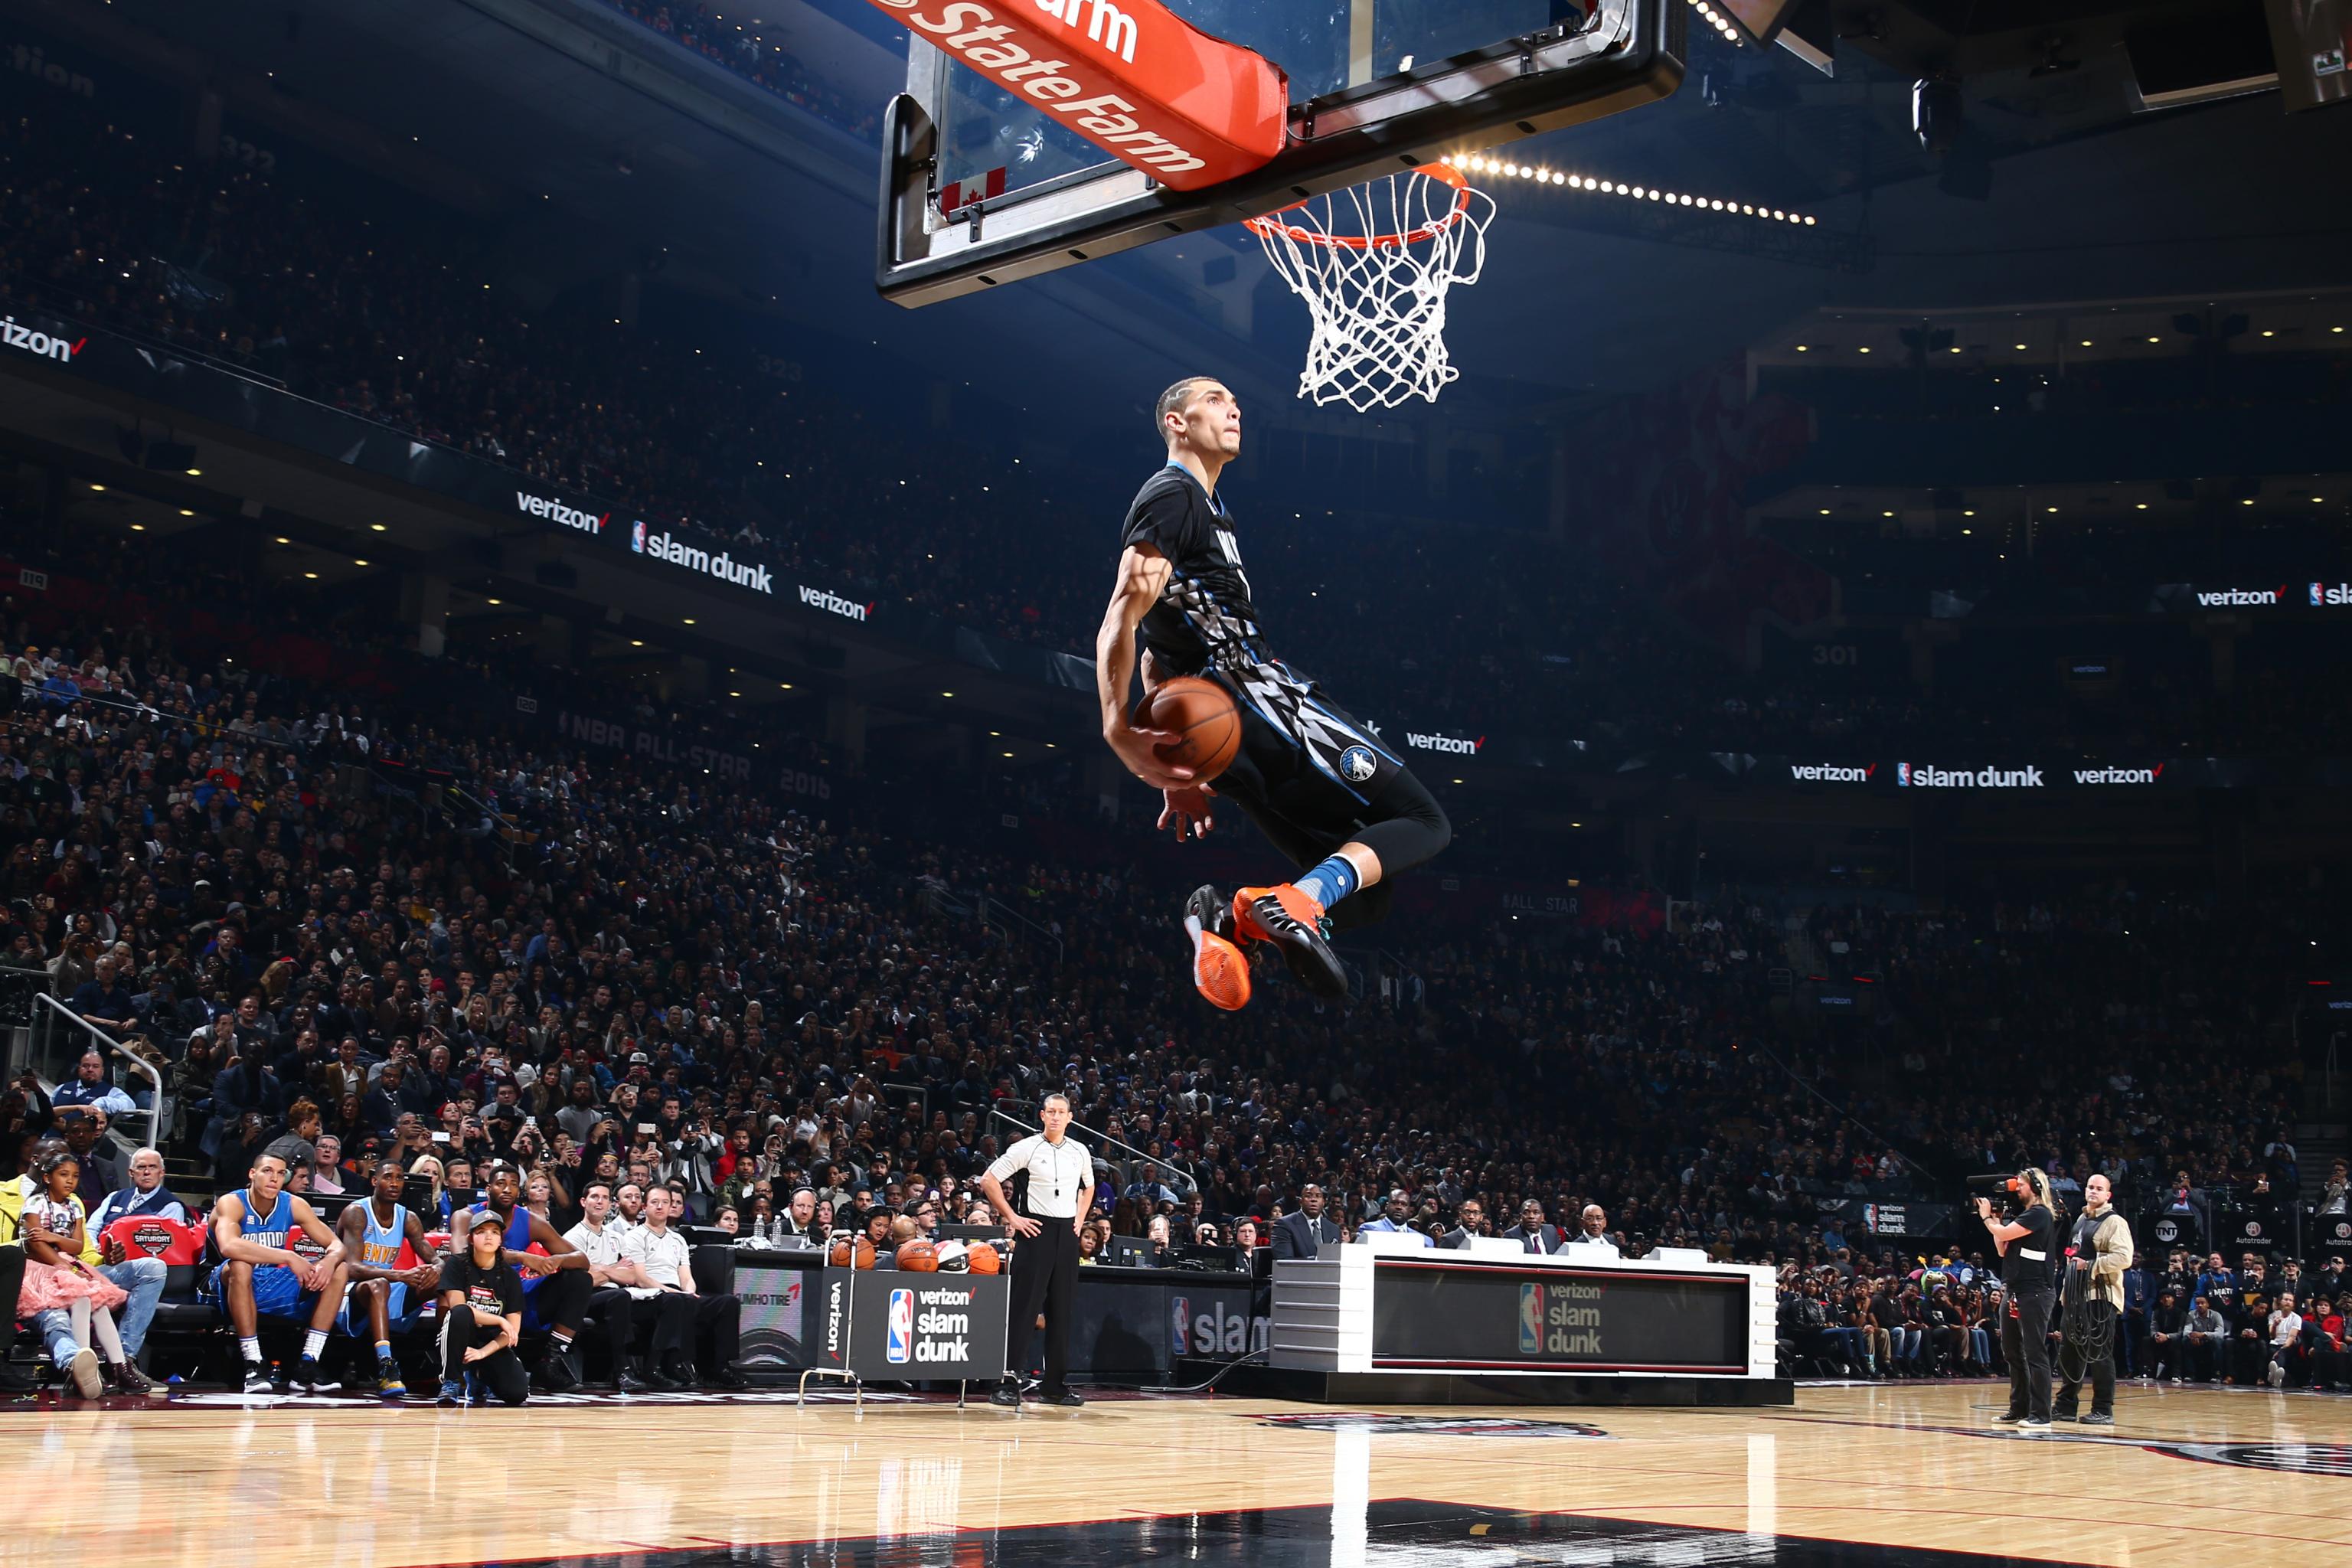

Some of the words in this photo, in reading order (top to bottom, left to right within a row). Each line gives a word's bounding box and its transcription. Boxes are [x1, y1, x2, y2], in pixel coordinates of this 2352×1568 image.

[516, 491, 599, 534] verizon
[646, 531, 710, 574] slam
[710, 551, 773, 594] dunk
[799, 584, 866, 622] verizon
[2197, 587, 2277, 606] verizon
[1812, 645, 1857, 665] 301
[572, 714, 625, 750] NBA
[635, 731, 751, 781] ALL-STAR
[1406, 732, 1476, 755] verizon
[1791, 763, 1867, 782] verizon
[1913, 765, 1975, 788] slam
[1976, 765, 2044, 788] dunk
[2073, 765, 2154, 785] verizon
[1511, 893, 1534, 910] ALL
[1546, 897, 1579, 914] STAR
[2155, 1227, 2177, 1237] TNT
[2236, 1236, 2272, 1245] Autotrader
[294, 1244, 327, 1253] SATURDA
[769, 1294, 791, 1306] TIRE
[919, 1287, 969, 1305] verizon
[1550, 1282, 1600, 1298] verizon
[828, 1281, 842, 1351] verizon
[917, 1307, 969, 1334] slam
[1549, 1301, 1601, 1326] slam
[915, 1334, 969, 1362] dunk
[1547, 1328, 1602, 1354] dunk
